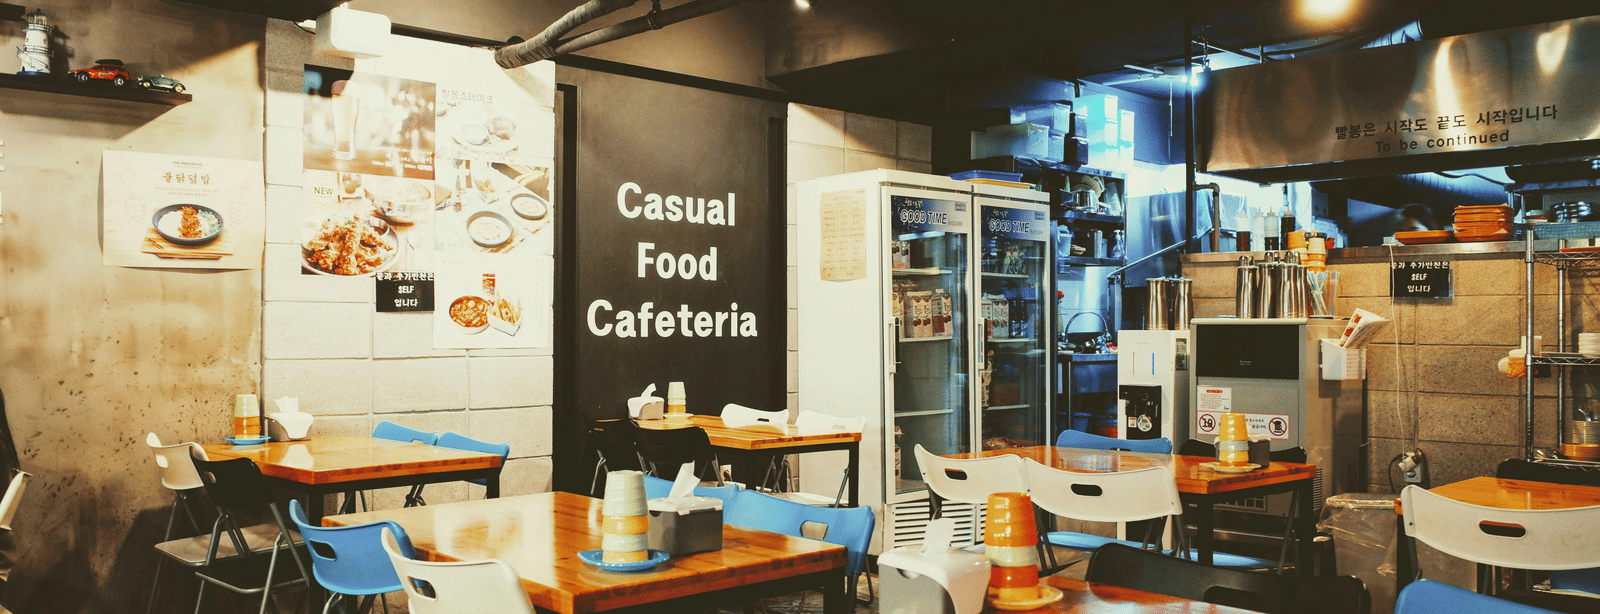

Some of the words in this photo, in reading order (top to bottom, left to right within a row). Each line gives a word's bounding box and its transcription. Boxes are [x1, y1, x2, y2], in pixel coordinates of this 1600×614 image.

[1335, 122, 1376, 140] 빨봉은
[1384, 118, 1428, 135] 시작도
[1436, 114, 1467, 130] 끝도
[1476, 104, 1558, 127] 시작입니다
[1375, 140, 1391, 153] To
[1400, 139, 1418, 150] be
[1426, 129, 1510, 149] continued
[313, 186, 334, 196] NEW
[617, 181, 736, 227] Casual
[900, 208, 927, 224] GOOD
[927, 210, 949, 226] TIME
[989, 218, 1012, 232] GOOD
[1012, 220, 1030, 233] TIME
[637, 241, 718, 282] Food
[1411, 273, 1428, 281] SELF
[397, 285, 415, 294] SELF
[1407, 285, 1431, 293] 입니다
[394, 298, 419, 308] 입니다
[586, 298, 758, 338] Cafeteria
